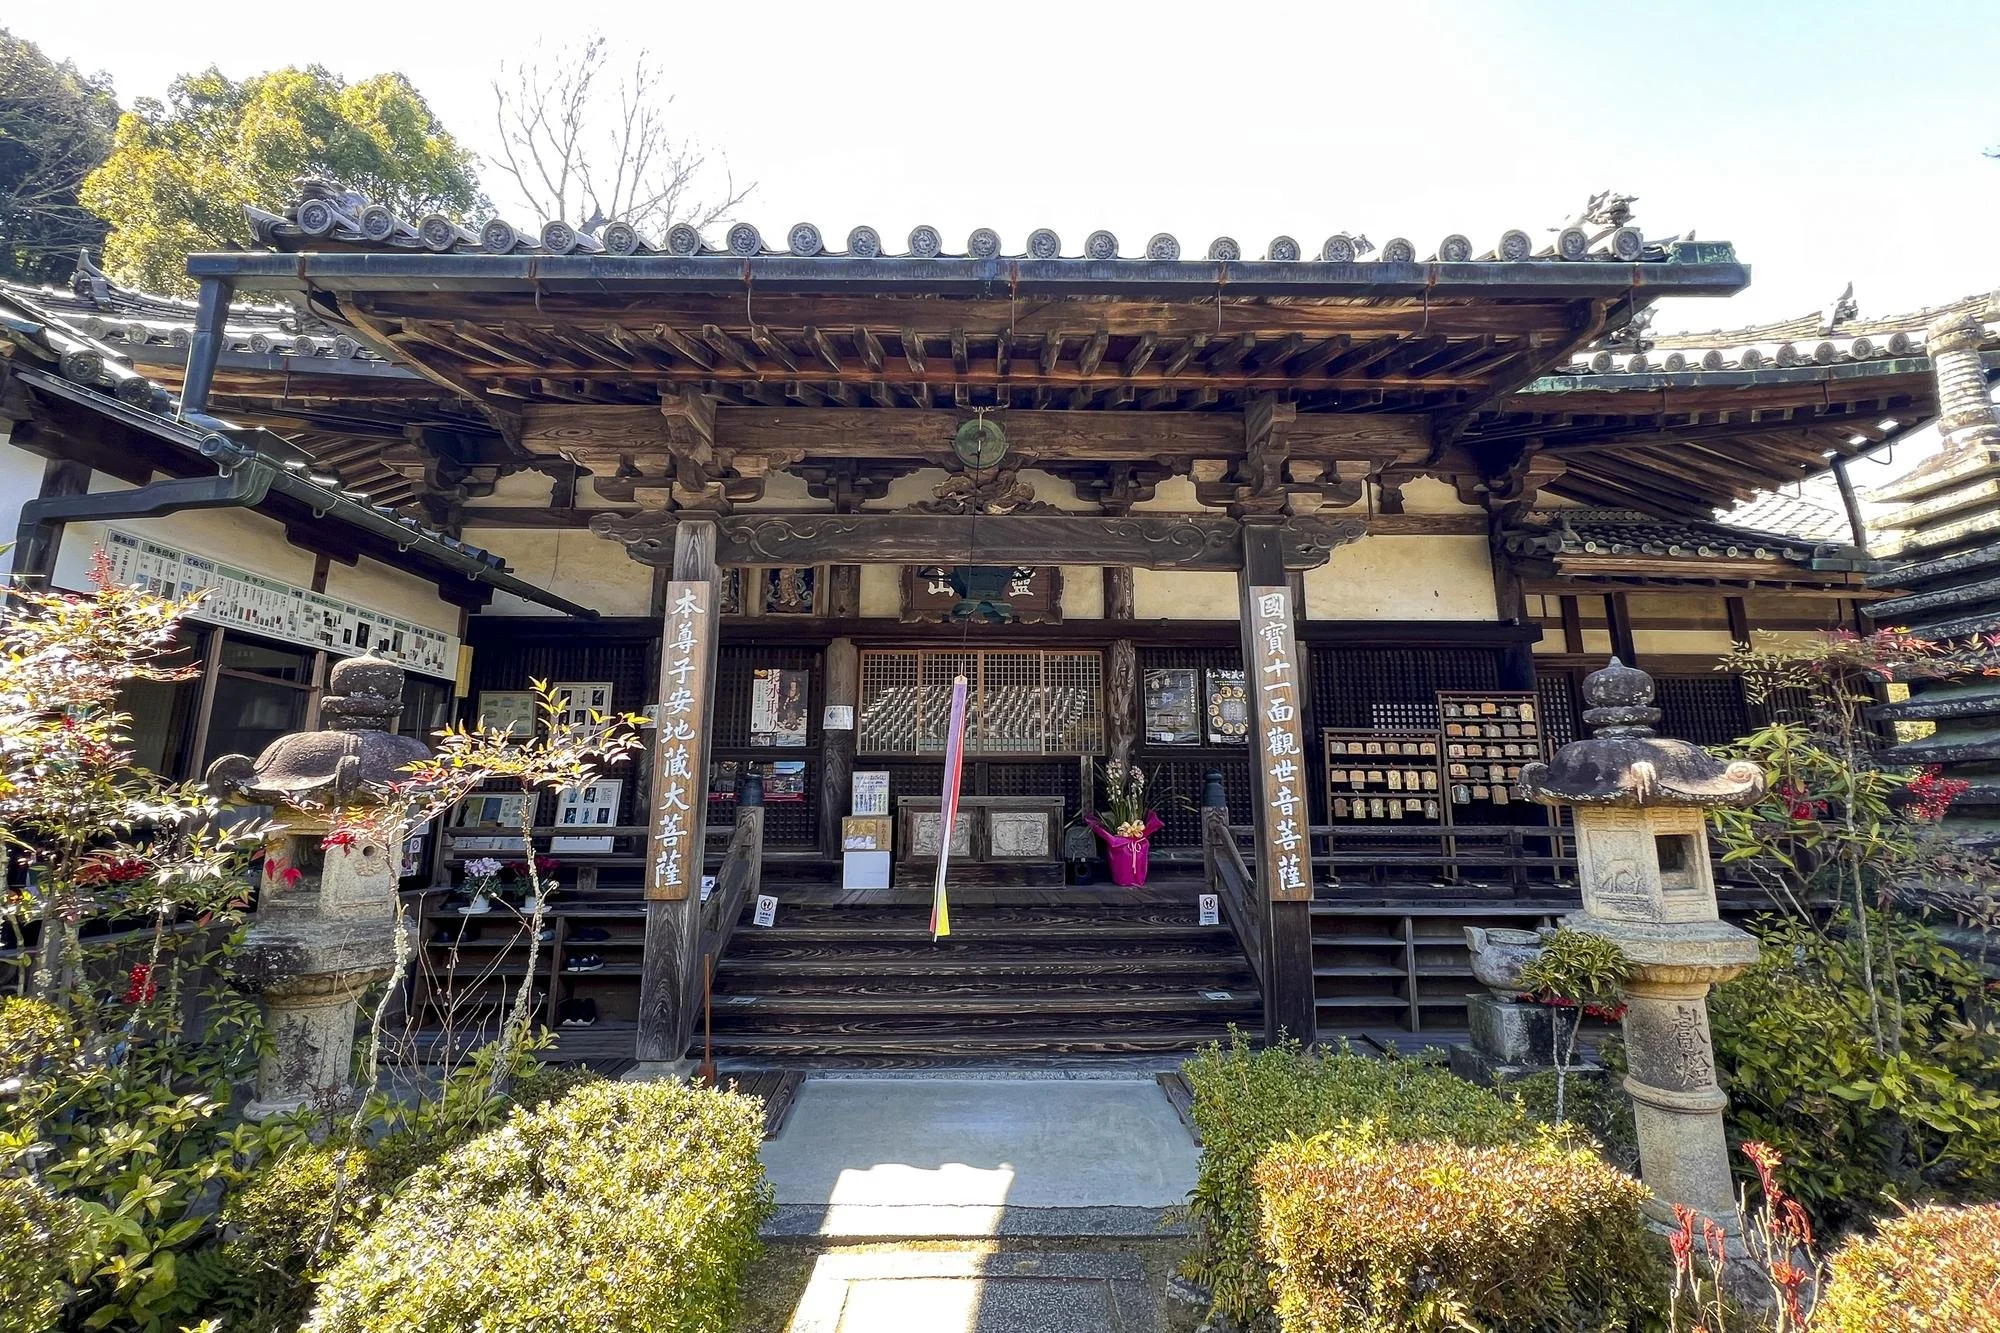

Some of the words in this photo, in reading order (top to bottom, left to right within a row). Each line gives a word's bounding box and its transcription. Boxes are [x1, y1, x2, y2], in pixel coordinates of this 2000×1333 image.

[655, 589, 704, 888] 本尊子安地蔵大菩薩
